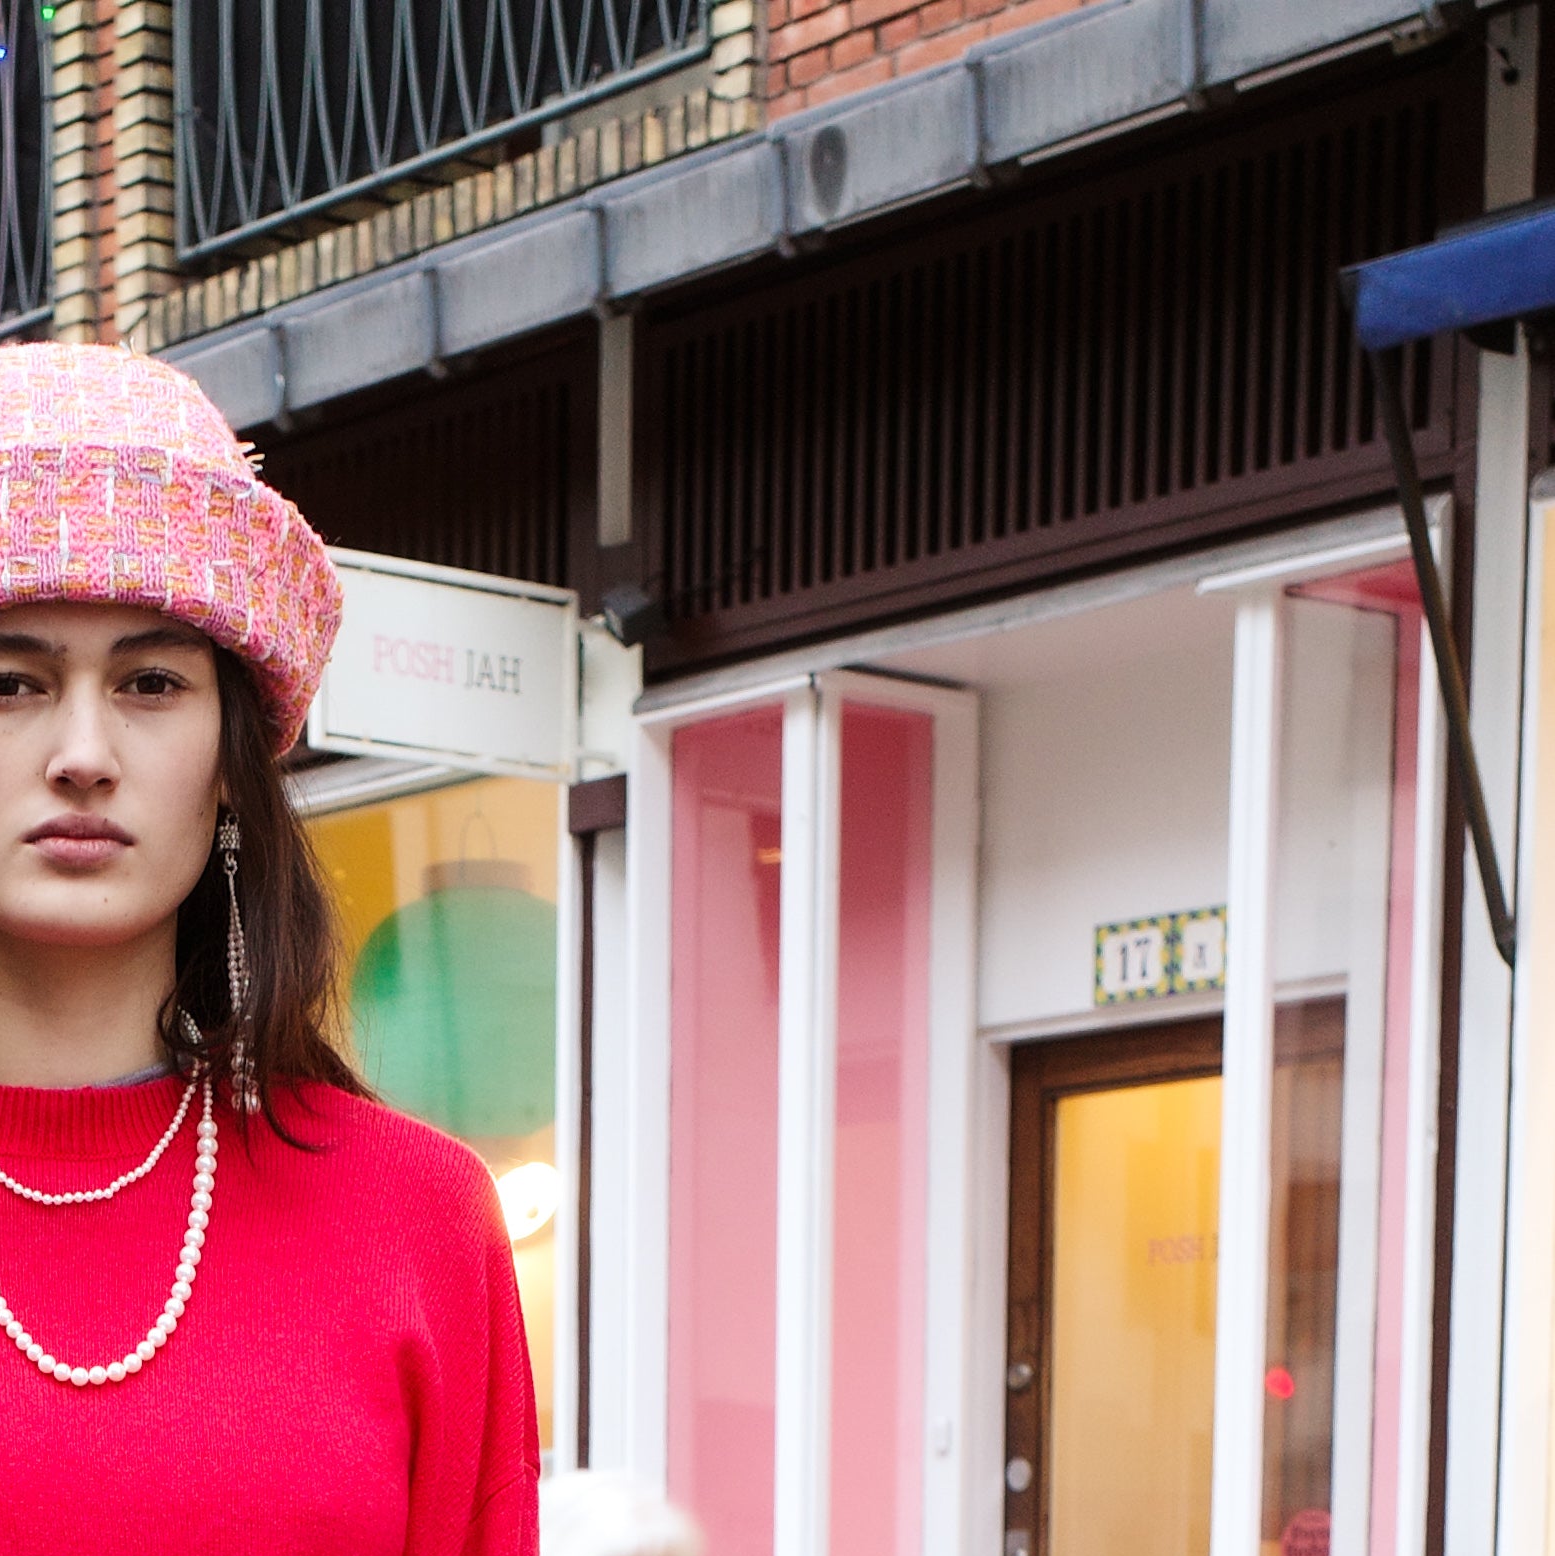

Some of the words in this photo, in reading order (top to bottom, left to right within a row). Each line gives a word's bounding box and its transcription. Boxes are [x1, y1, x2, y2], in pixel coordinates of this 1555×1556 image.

[373, 633, 455, 685] POSH
[1120, 936, 1150, 982] 17
[1146, 1234, 1204, 1267] POSH
